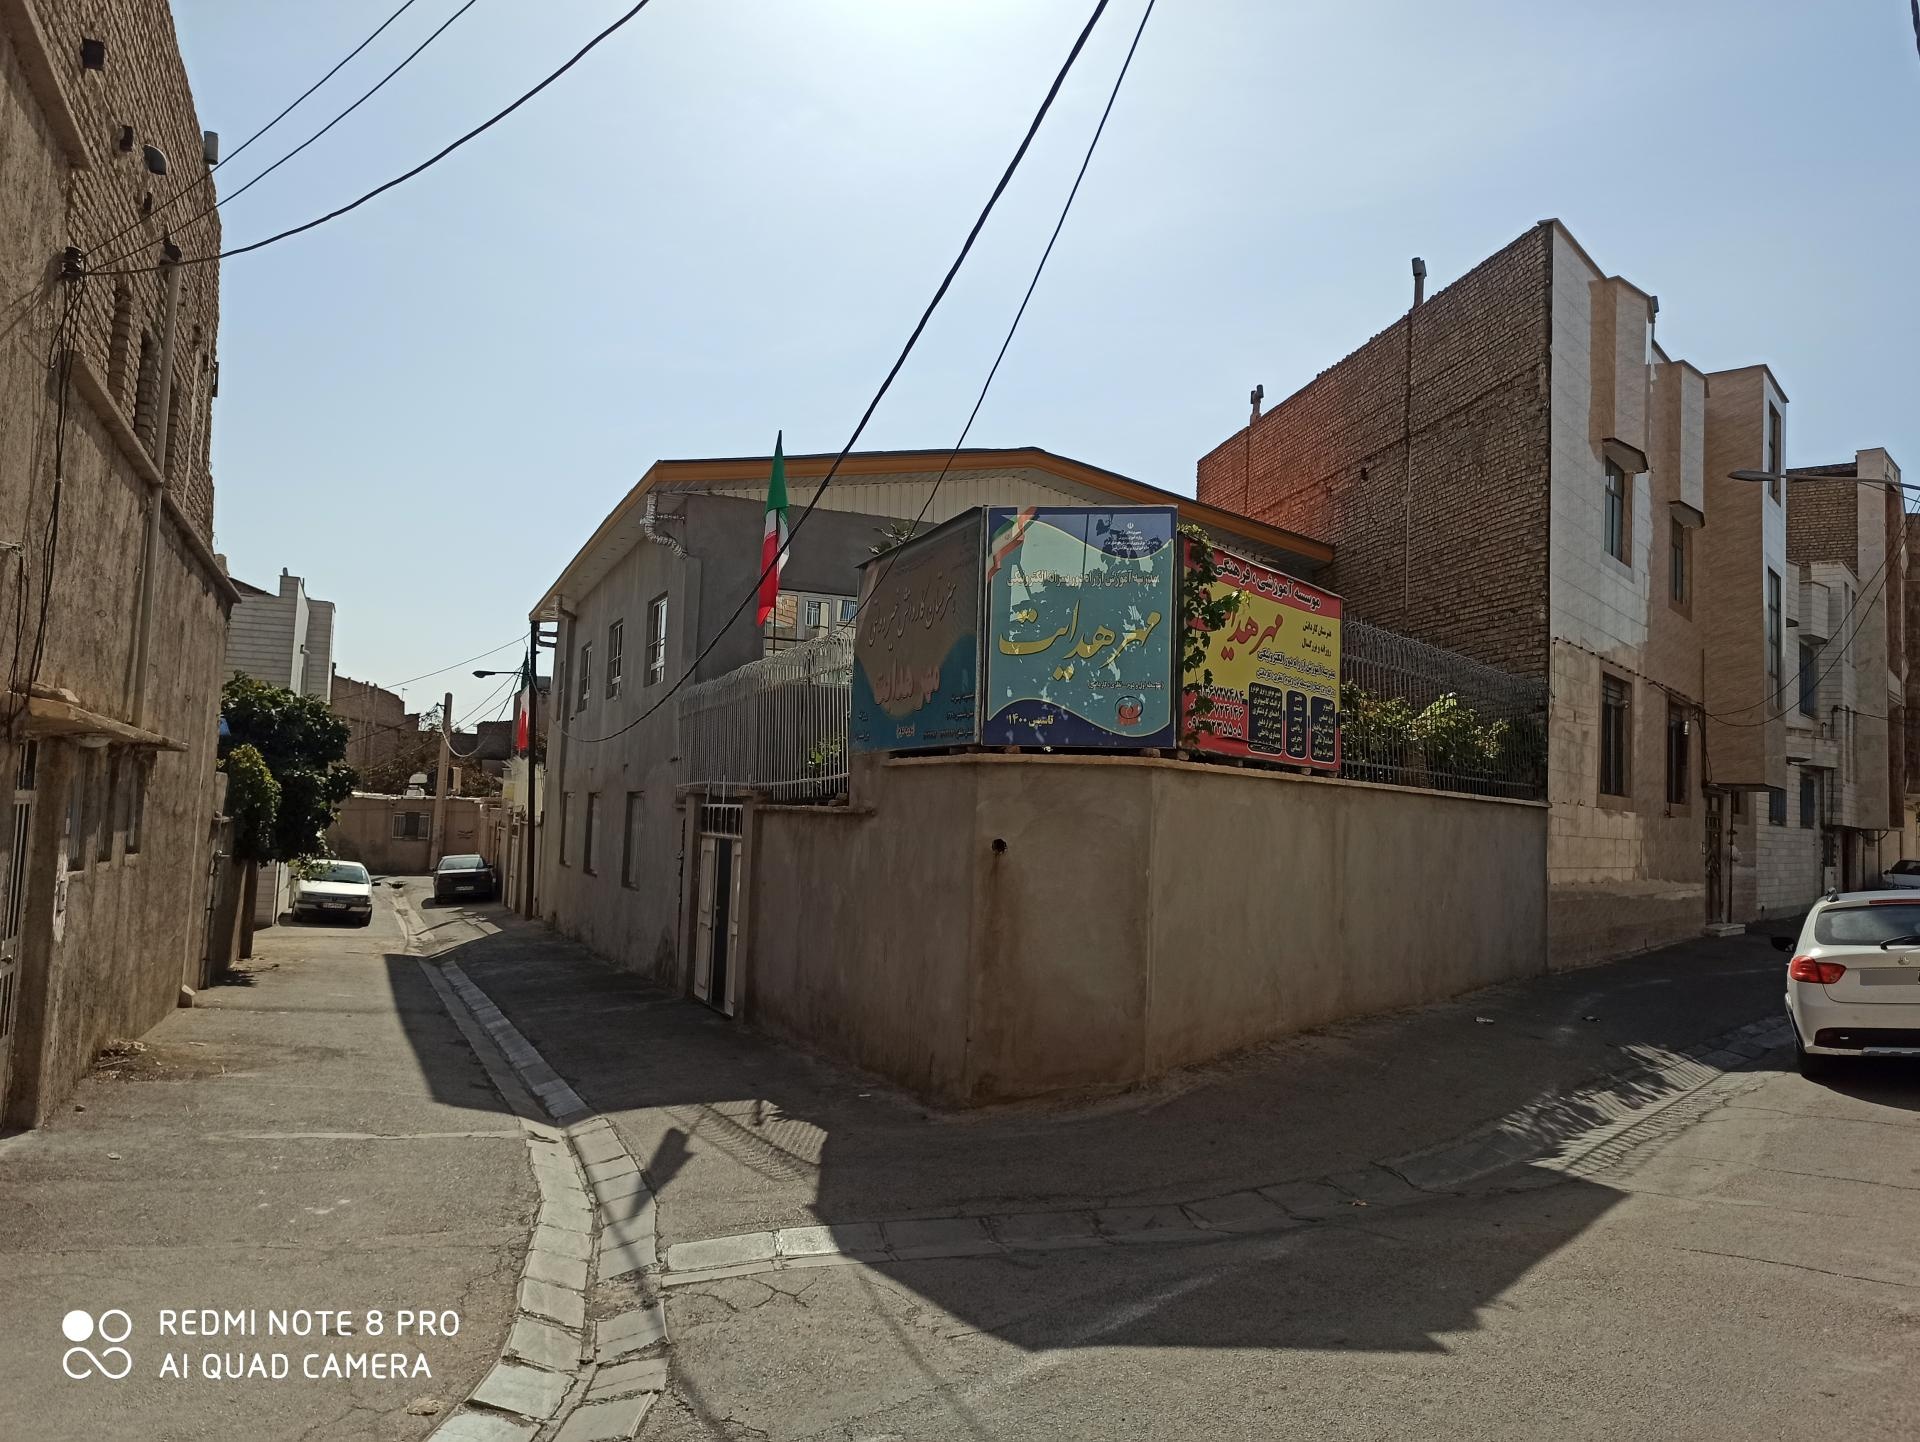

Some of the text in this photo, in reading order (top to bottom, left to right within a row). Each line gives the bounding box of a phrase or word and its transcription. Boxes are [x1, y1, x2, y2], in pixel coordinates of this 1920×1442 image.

[1133, 571, 1160, 589] مدرسه
[1213, 557, 1252, 585] فرهنگی
[1293, 587, 1321, 611] موسسه
[998, 599, 1162, 681] مهر هدایت
[1249, 612, 1283, 656] مهر
[1007, 713, 1055, 728] تاسیس ۱۴۰۰
